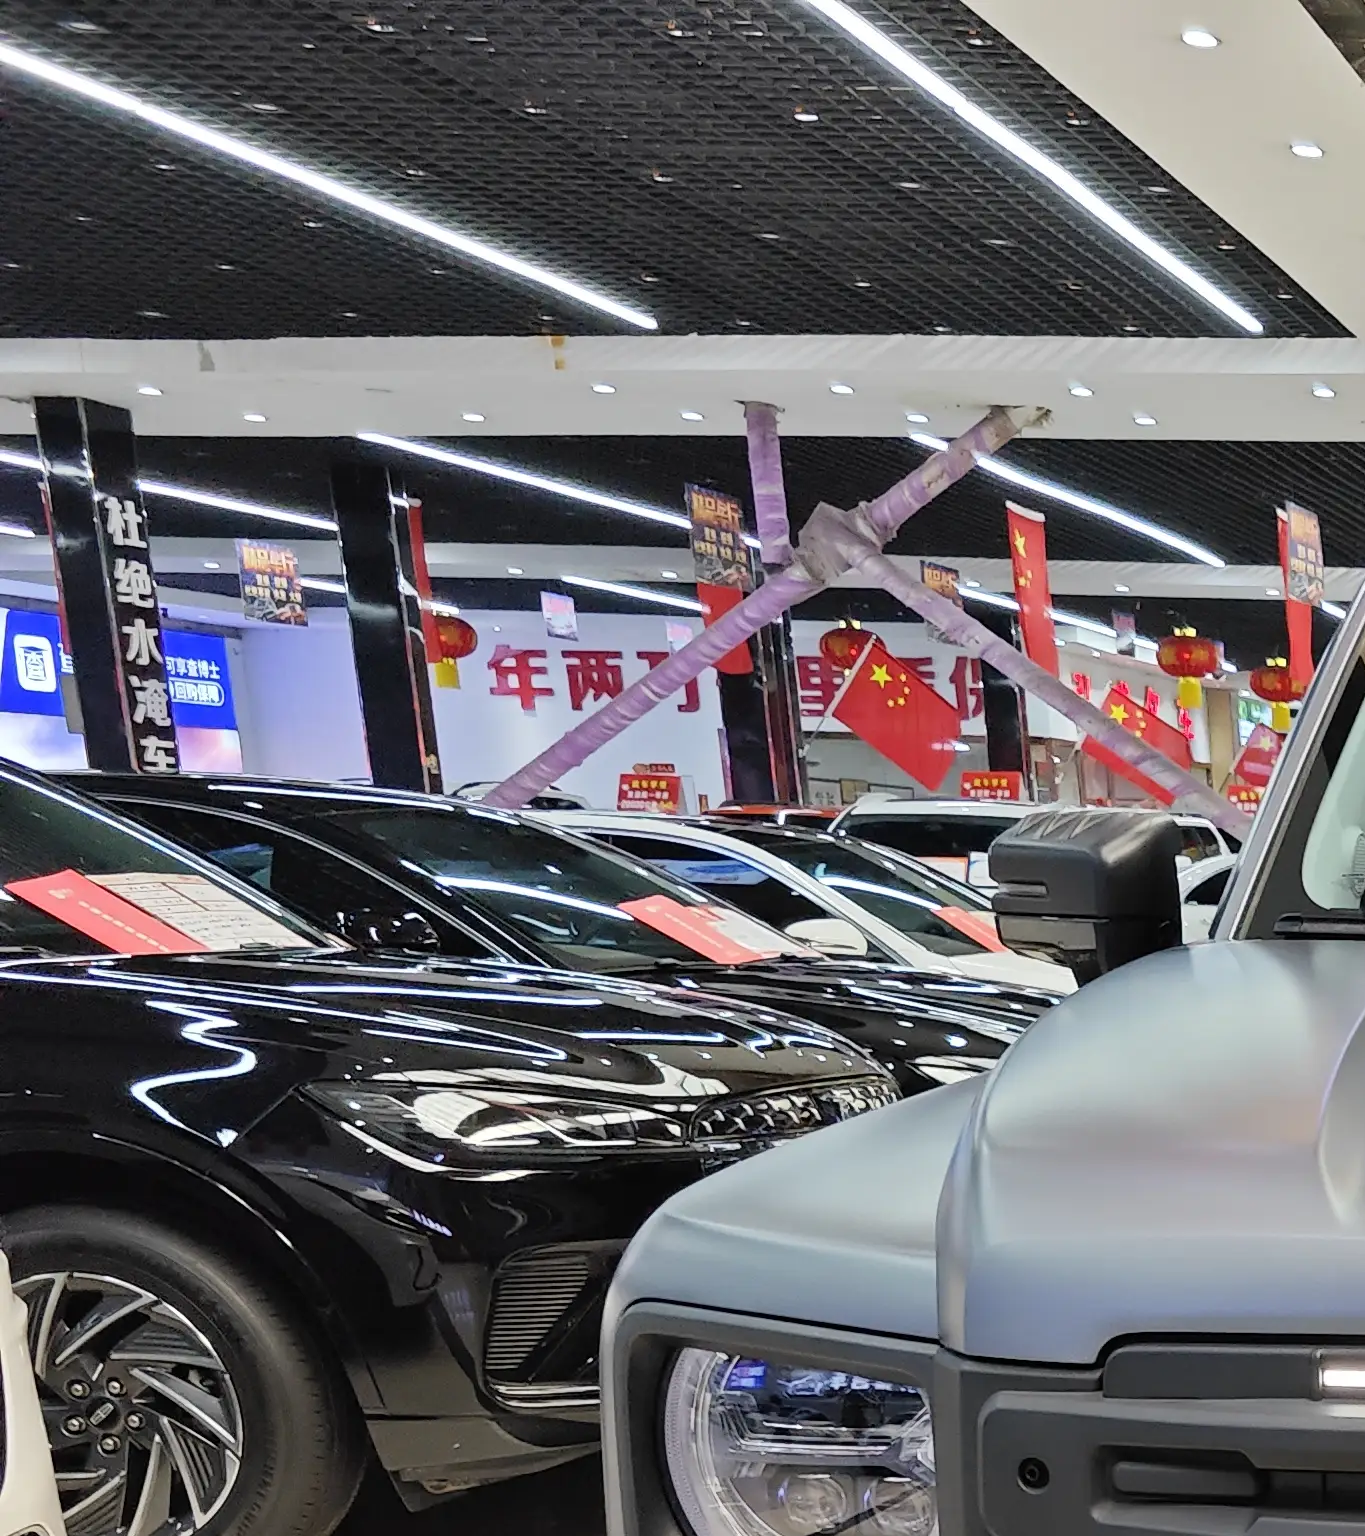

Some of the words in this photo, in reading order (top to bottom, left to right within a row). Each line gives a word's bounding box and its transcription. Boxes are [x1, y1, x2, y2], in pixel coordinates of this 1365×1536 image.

[104, 496, 179, 774] 杜绝水淹车
